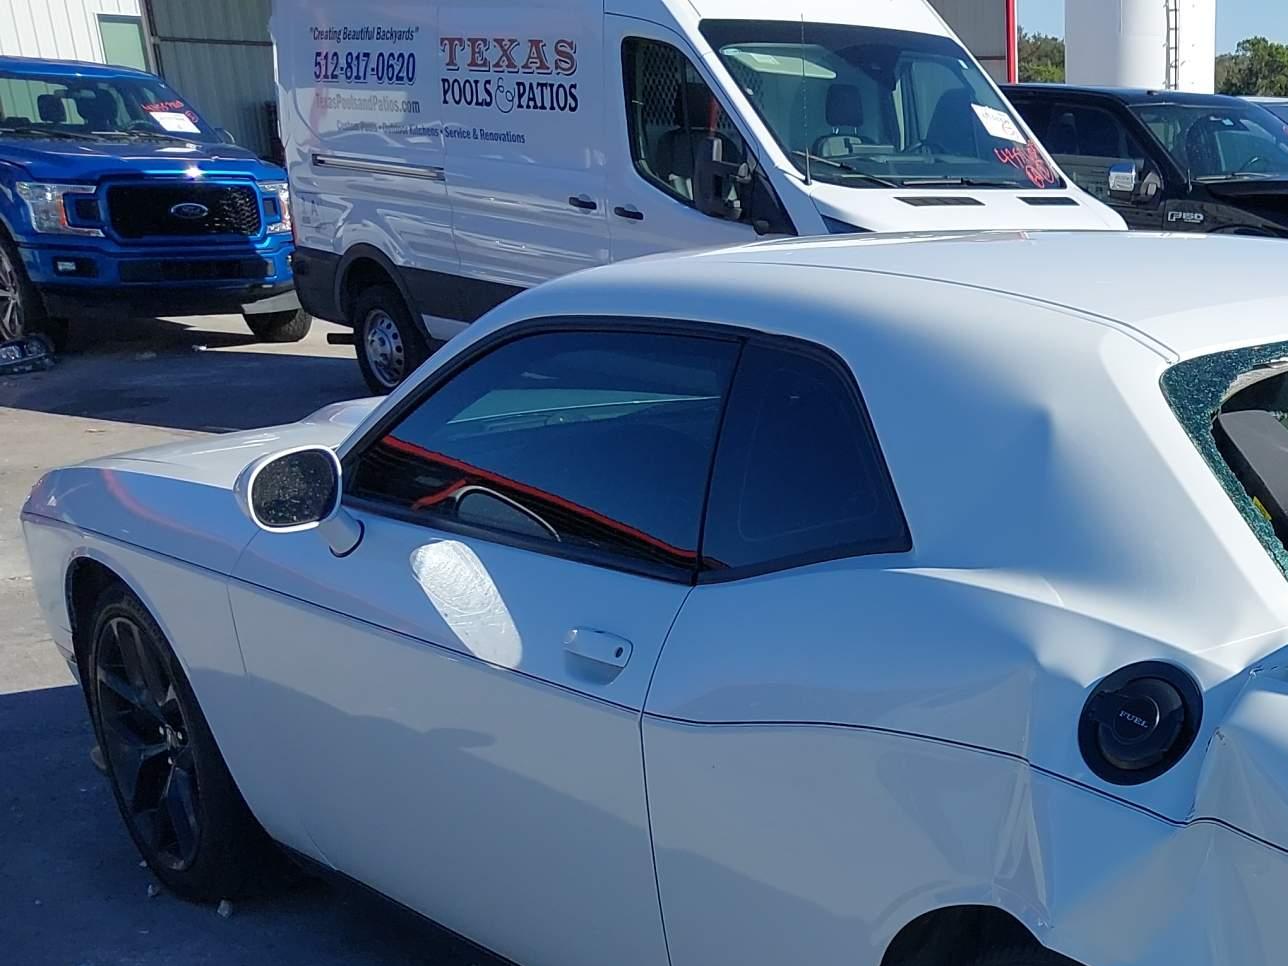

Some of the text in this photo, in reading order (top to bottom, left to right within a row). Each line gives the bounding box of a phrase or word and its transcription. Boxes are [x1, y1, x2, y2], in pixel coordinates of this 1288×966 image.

[309, 26, 420, 44] "Creating Beautiful Backyards"
[314, 51, 417, 85] 512-817-0620
[440, 37, 577, 76] TEXAS
[441, 77, 493, 107] POOLS
[516, 81, 579, 113] PATIOS
[444, 126, 471, 140] Service
[472, 128, 479, 140] &
[480, 128, 526, 144] Renovations
[1119, 710, 1149, 729] FUEL
